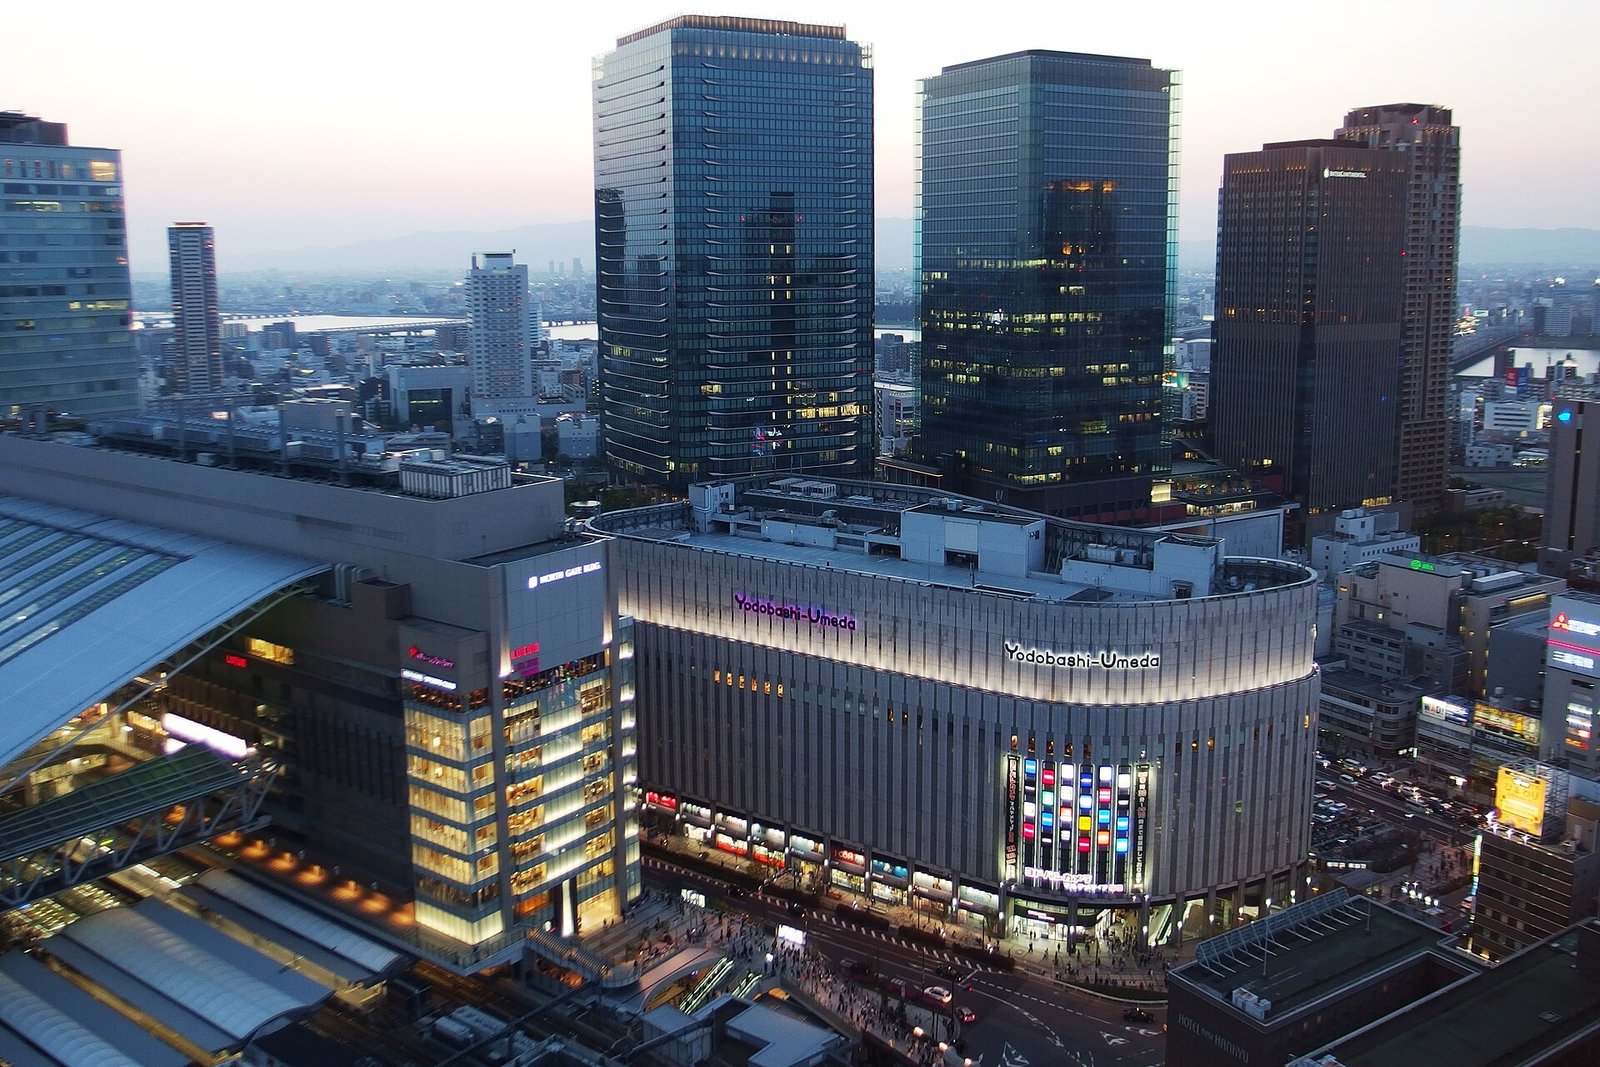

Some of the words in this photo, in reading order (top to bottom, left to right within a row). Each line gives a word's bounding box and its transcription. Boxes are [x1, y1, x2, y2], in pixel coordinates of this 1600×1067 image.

[735, 594, 856, 630] Yodobashi-Umeda
[1004, 643, 1160, 669] Yodobashi-Umeda
[1178, 1012, 1200, 1035] HOTEL
[1214, 1033, 1249, 1064] HANKYU
